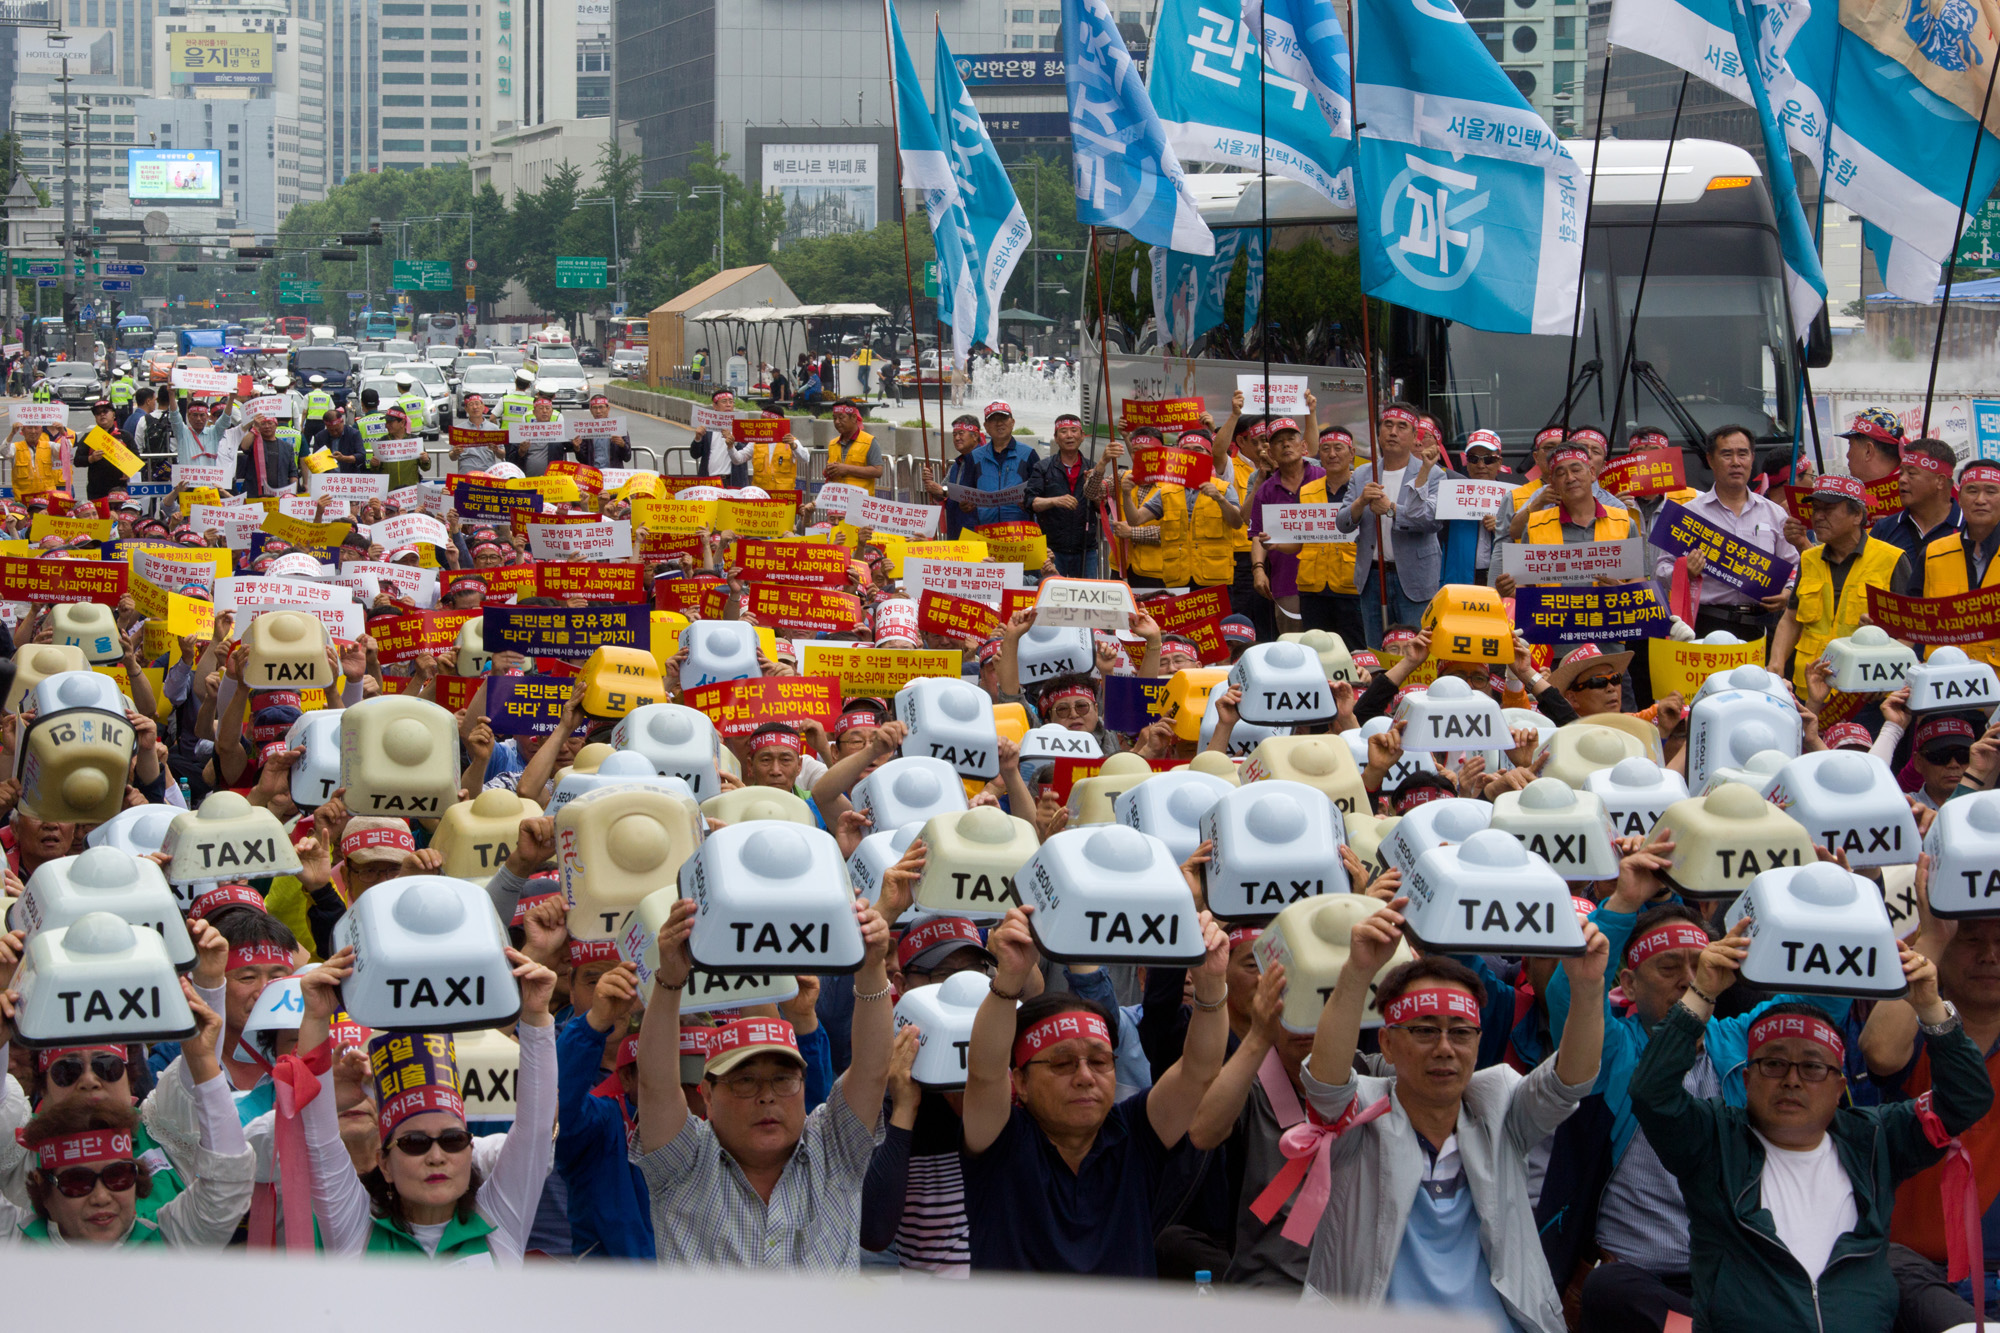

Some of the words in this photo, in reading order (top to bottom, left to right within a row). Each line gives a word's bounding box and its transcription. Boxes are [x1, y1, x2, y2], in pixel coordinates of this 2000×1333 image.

[52, 52, 88, 60] GRACERY
[230, 48, 260, 56] 대학교
[498, 0, 511, 96] 별시의회
[184, 47, 228, 68] 을지
[972, 61, 1037, 78] 신한은행
[774, 160, 822, 174] 베르나르
[1858, 420, 1873, 433] GO
[1920, 457, 1938, 470] GO
[1846, 483, 1860, 495] GO
[862, 499, 903, 515] 교통생태계
[905, 508, 928, 519] 교란종
[1280, 508, 1325, 519] 교통생태계
[541, 528, 582, 539] 교통생태계
[585, 526, 613, 538] 교란종
[763, 519, 779, 528] OUT!
[573, 538, 614, 550] 박멸하라!
[1681, 515, 1725, 543] 국민분열
[1726, 539, 1772, 570] 공유경제
[746, 545, 765, 557] 불법
[806, 546, 845, 562] 방관하는
[1524, 549, 1584, 562] 교통생태계
[1587, 545, 1622, 558] 교란종
[6, 564, 28, 574] 불법
[74, 567, 119, 580] 방관하는
[544, 566, 561, 577] 불법
[599, 567, 635, 579] 방관하는
[745, 558, 789, 572] 대통령님,
[793, 561, 845, 573] 사과하세요!
[922, 564, 973, 578] 교통생태계
[975, 568, 1006, 580] 교란종
[1571, 559, 1622, 572] 박멸하라!
[5, 577, 53, 590] 대통령님,
[57, 580, 118, 593] 사과하세요!
[234, 582, 293, 595] 교통생태계
[295, 586, 331, 600] 교란종
[544, 579, 581, 590] 대통령님,
[584, 579, 634, 590] 사과하세요!
[759, 588, 780, 601] 불법
[820, 596, 857, 610] 방관하는
[1068, 589, 1106, 603] TAXI
[1540, 594, 1600, 609] 국민분열
[1604, 589, 1656, 608] 공유경제
[758, 602, 802, 617] 대통령님,
[806, 607, 857, 621] 사과하세요!
[1462, 601, 1490, 612] TAXI
[510, 614, 566, 628] 국민분열
[571, 614, 626, 628] 공유경제
[1574, 612, 1604, 626] 퇴출
[1608, 608, 1666, 624] 그날까지!
[542, 631, 569, 644] 퇴출
[574, 631, 635, 644] 그날까지!
[1452, 636, 1499, 657] 모범
[819, 654, 843, 668] 악법
[849, 654, 861, 667] 중
[867, 655, 891, 668] 악법
[896, 657, 948, 671] 택시부제
[1026, 658, 1074, 677] TAXI
[1675, 650, 1748, 667] 대통령까지
[264, 663, 314, 681] TAXI
[616, 664, 645, 676] TAXI
[695, 689, 721, 707] 불법
[778, 684, 829, 698] 방관하는
[1930, 678, 1989, 700] TAXI
[1263, 692, 1319, 710] TAXI
[1428, 714, 1491, 738] TAXI
[1036, 736, 1090, 753] TAXI
[929, 743, 986, 769] TAXI
[370, 794, 438, 812] TAXI
[1821, 825, 1901, 853] TAXI
[197, 837, 276, 868] TAXI
[1717, 849, 1800, 878] TAXI
[1240, 880, 1323, 904] TAXI
[1458, 898, 1554, 934] TAXI
[909, 921, 955, 949] 정치적
[1085, 911, 1179, 945] TAXI
[730, 922, 830, 953] TAXI
[1781, 941, 1877, 977] TAXI
[386, 976, 485, 1008] TAXI
[58, 986, 161, 1023] TAXI
[748, 1024, 784, 1041] 결단
[1026, 1016, 1079, 1048] 정치적
[62, 1138, 103, 1158] 결단
[111, 1137, 132, 1153] GO
